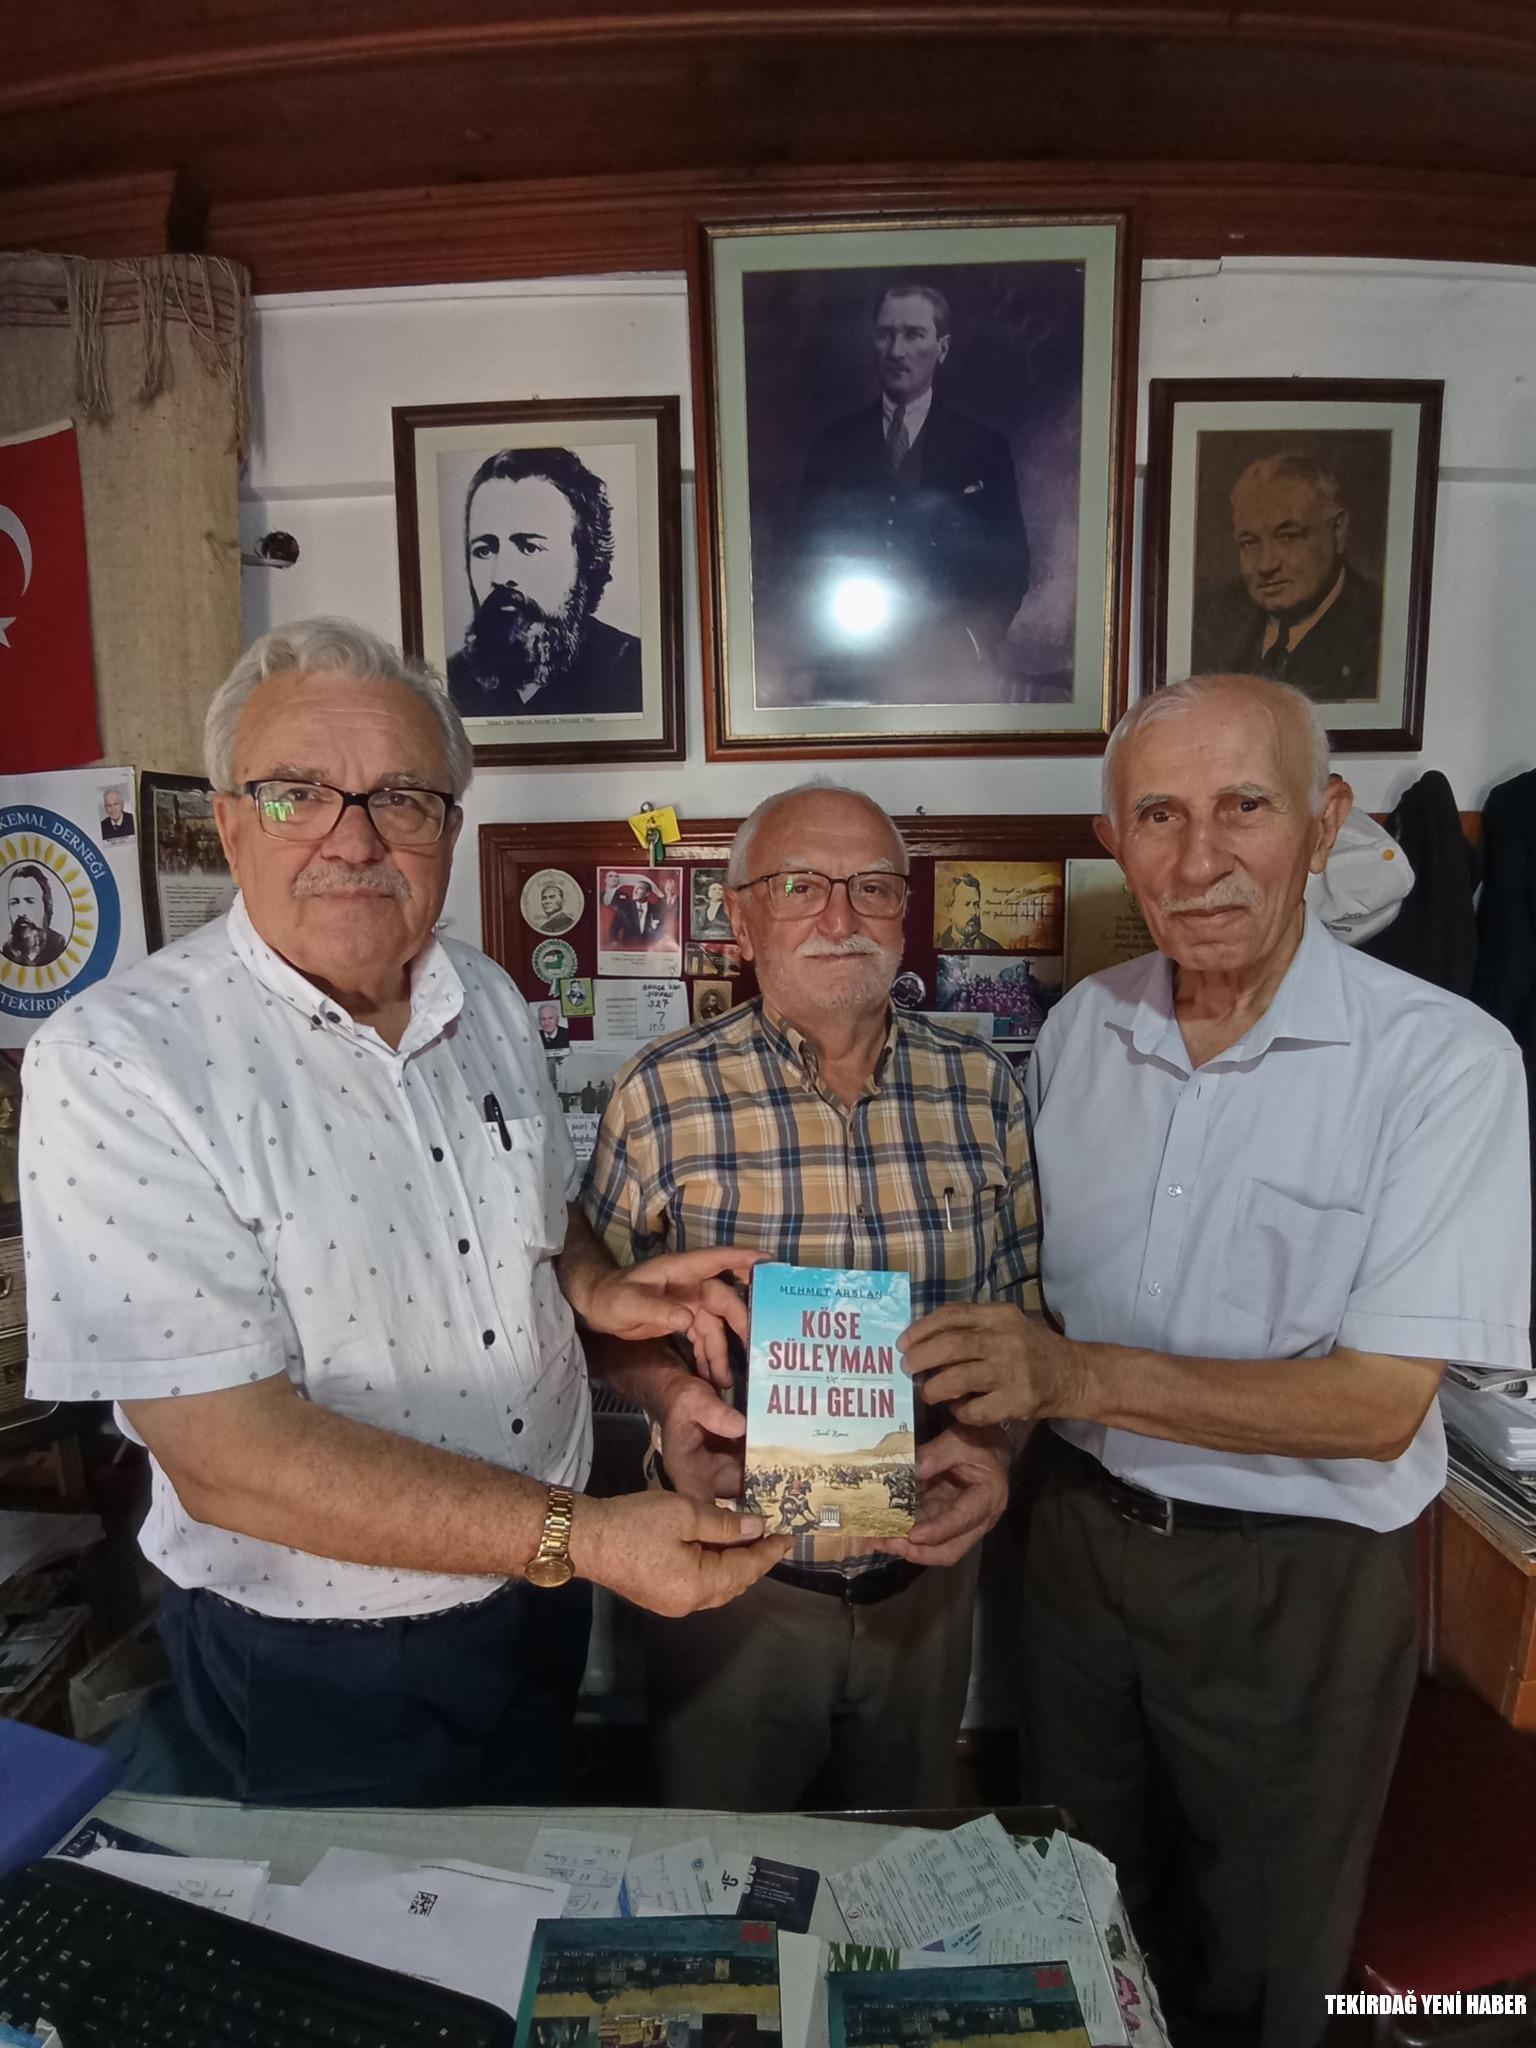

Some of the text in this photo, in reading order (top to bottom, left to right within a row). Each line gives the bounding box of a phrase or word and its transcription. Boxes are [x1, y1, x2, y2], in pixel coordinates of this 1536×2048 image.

[52, 821, 107, 880] DERNEĞİ
[780, 1286, 883, 1300] MEHMET ARSLAN
[801, 1306, 862, 1340] KÖSE
[768, 1338, 894, 1375] SÜLEYMAN
[766, 1384, 895, 1419] ALLI GELİN
